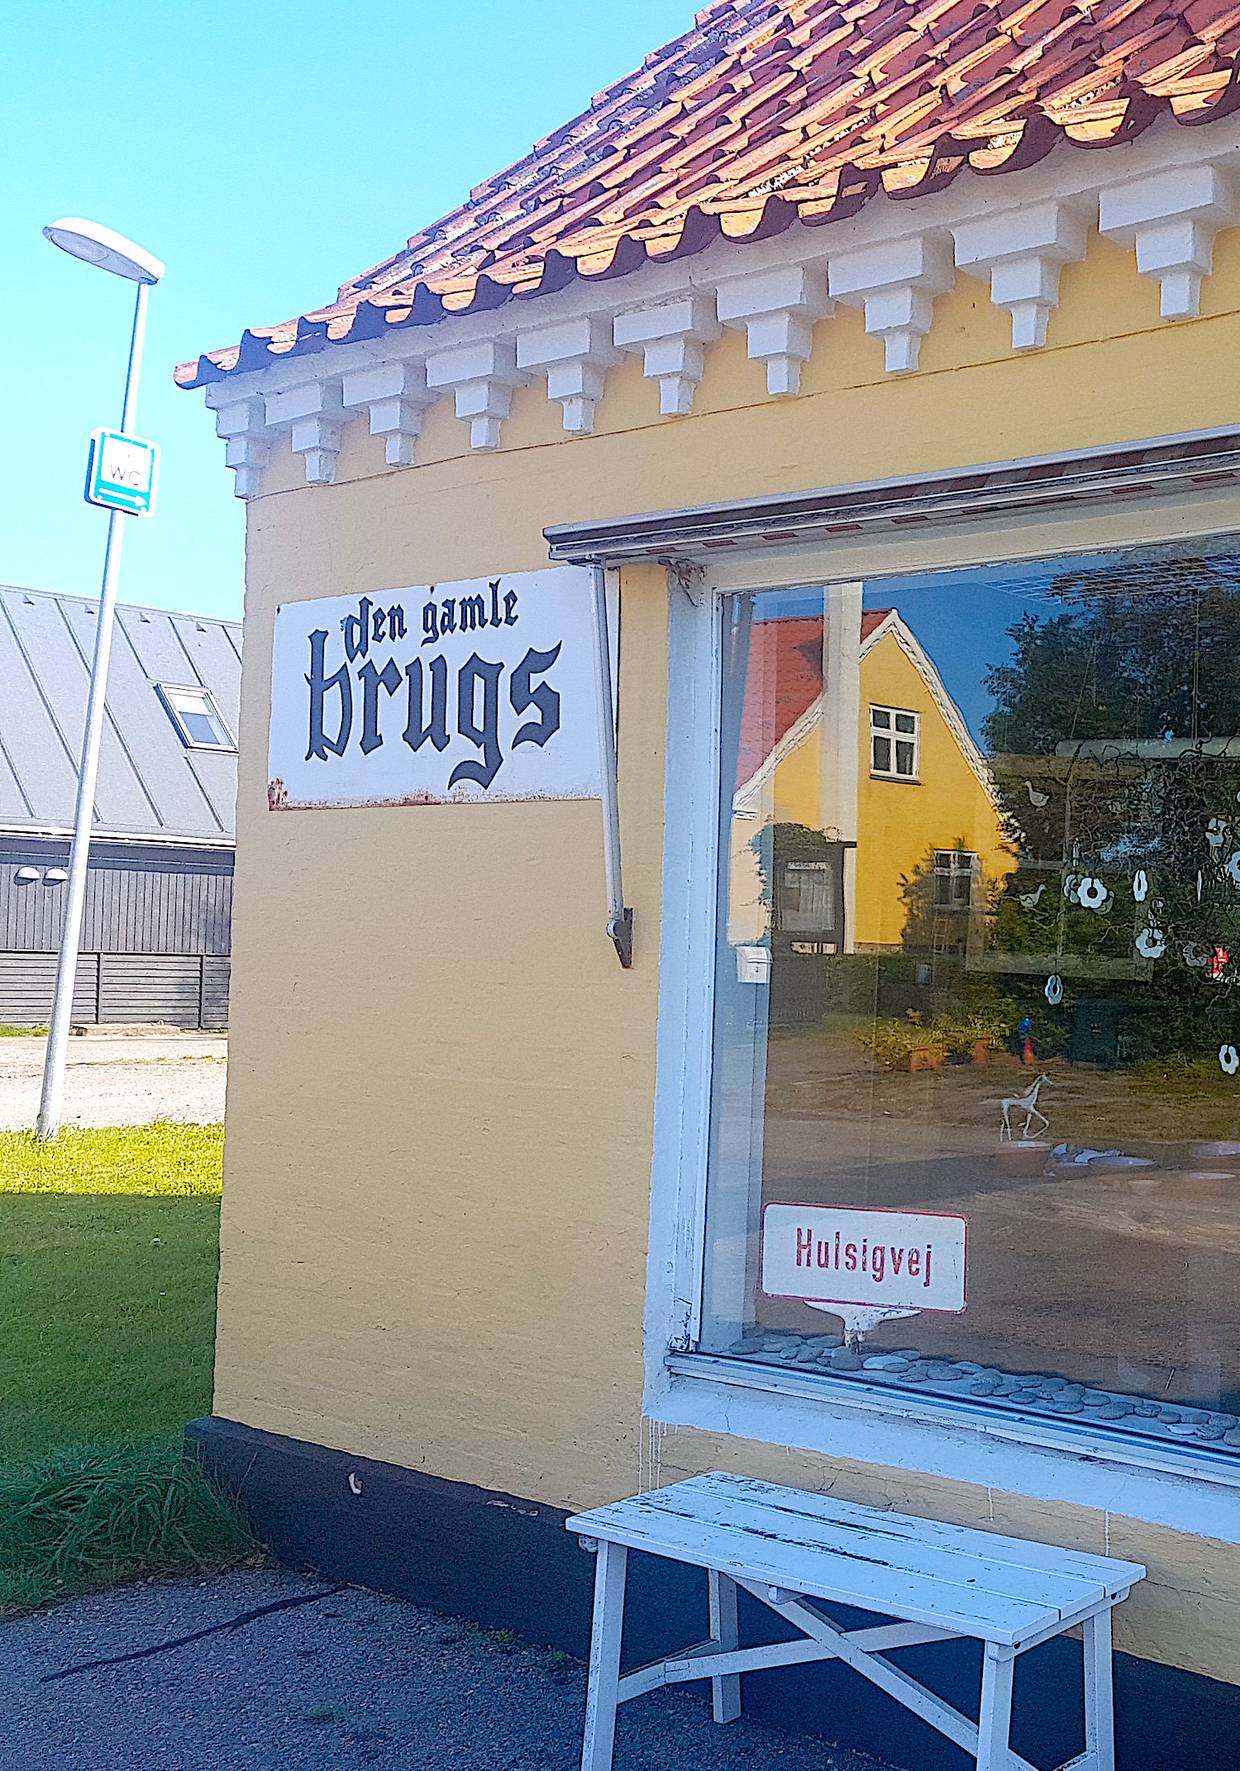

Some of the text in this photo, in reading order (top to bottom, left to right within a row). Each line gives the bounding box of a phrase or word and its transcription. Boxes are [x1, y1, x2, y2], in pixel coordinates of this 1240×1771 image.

[110, 464, 141, 486] WC
[343, 578, 520, 663] den gamle
[303, 628, 562, 791] brugs
[796, 1227, 933, 1288] Hulsigvej
